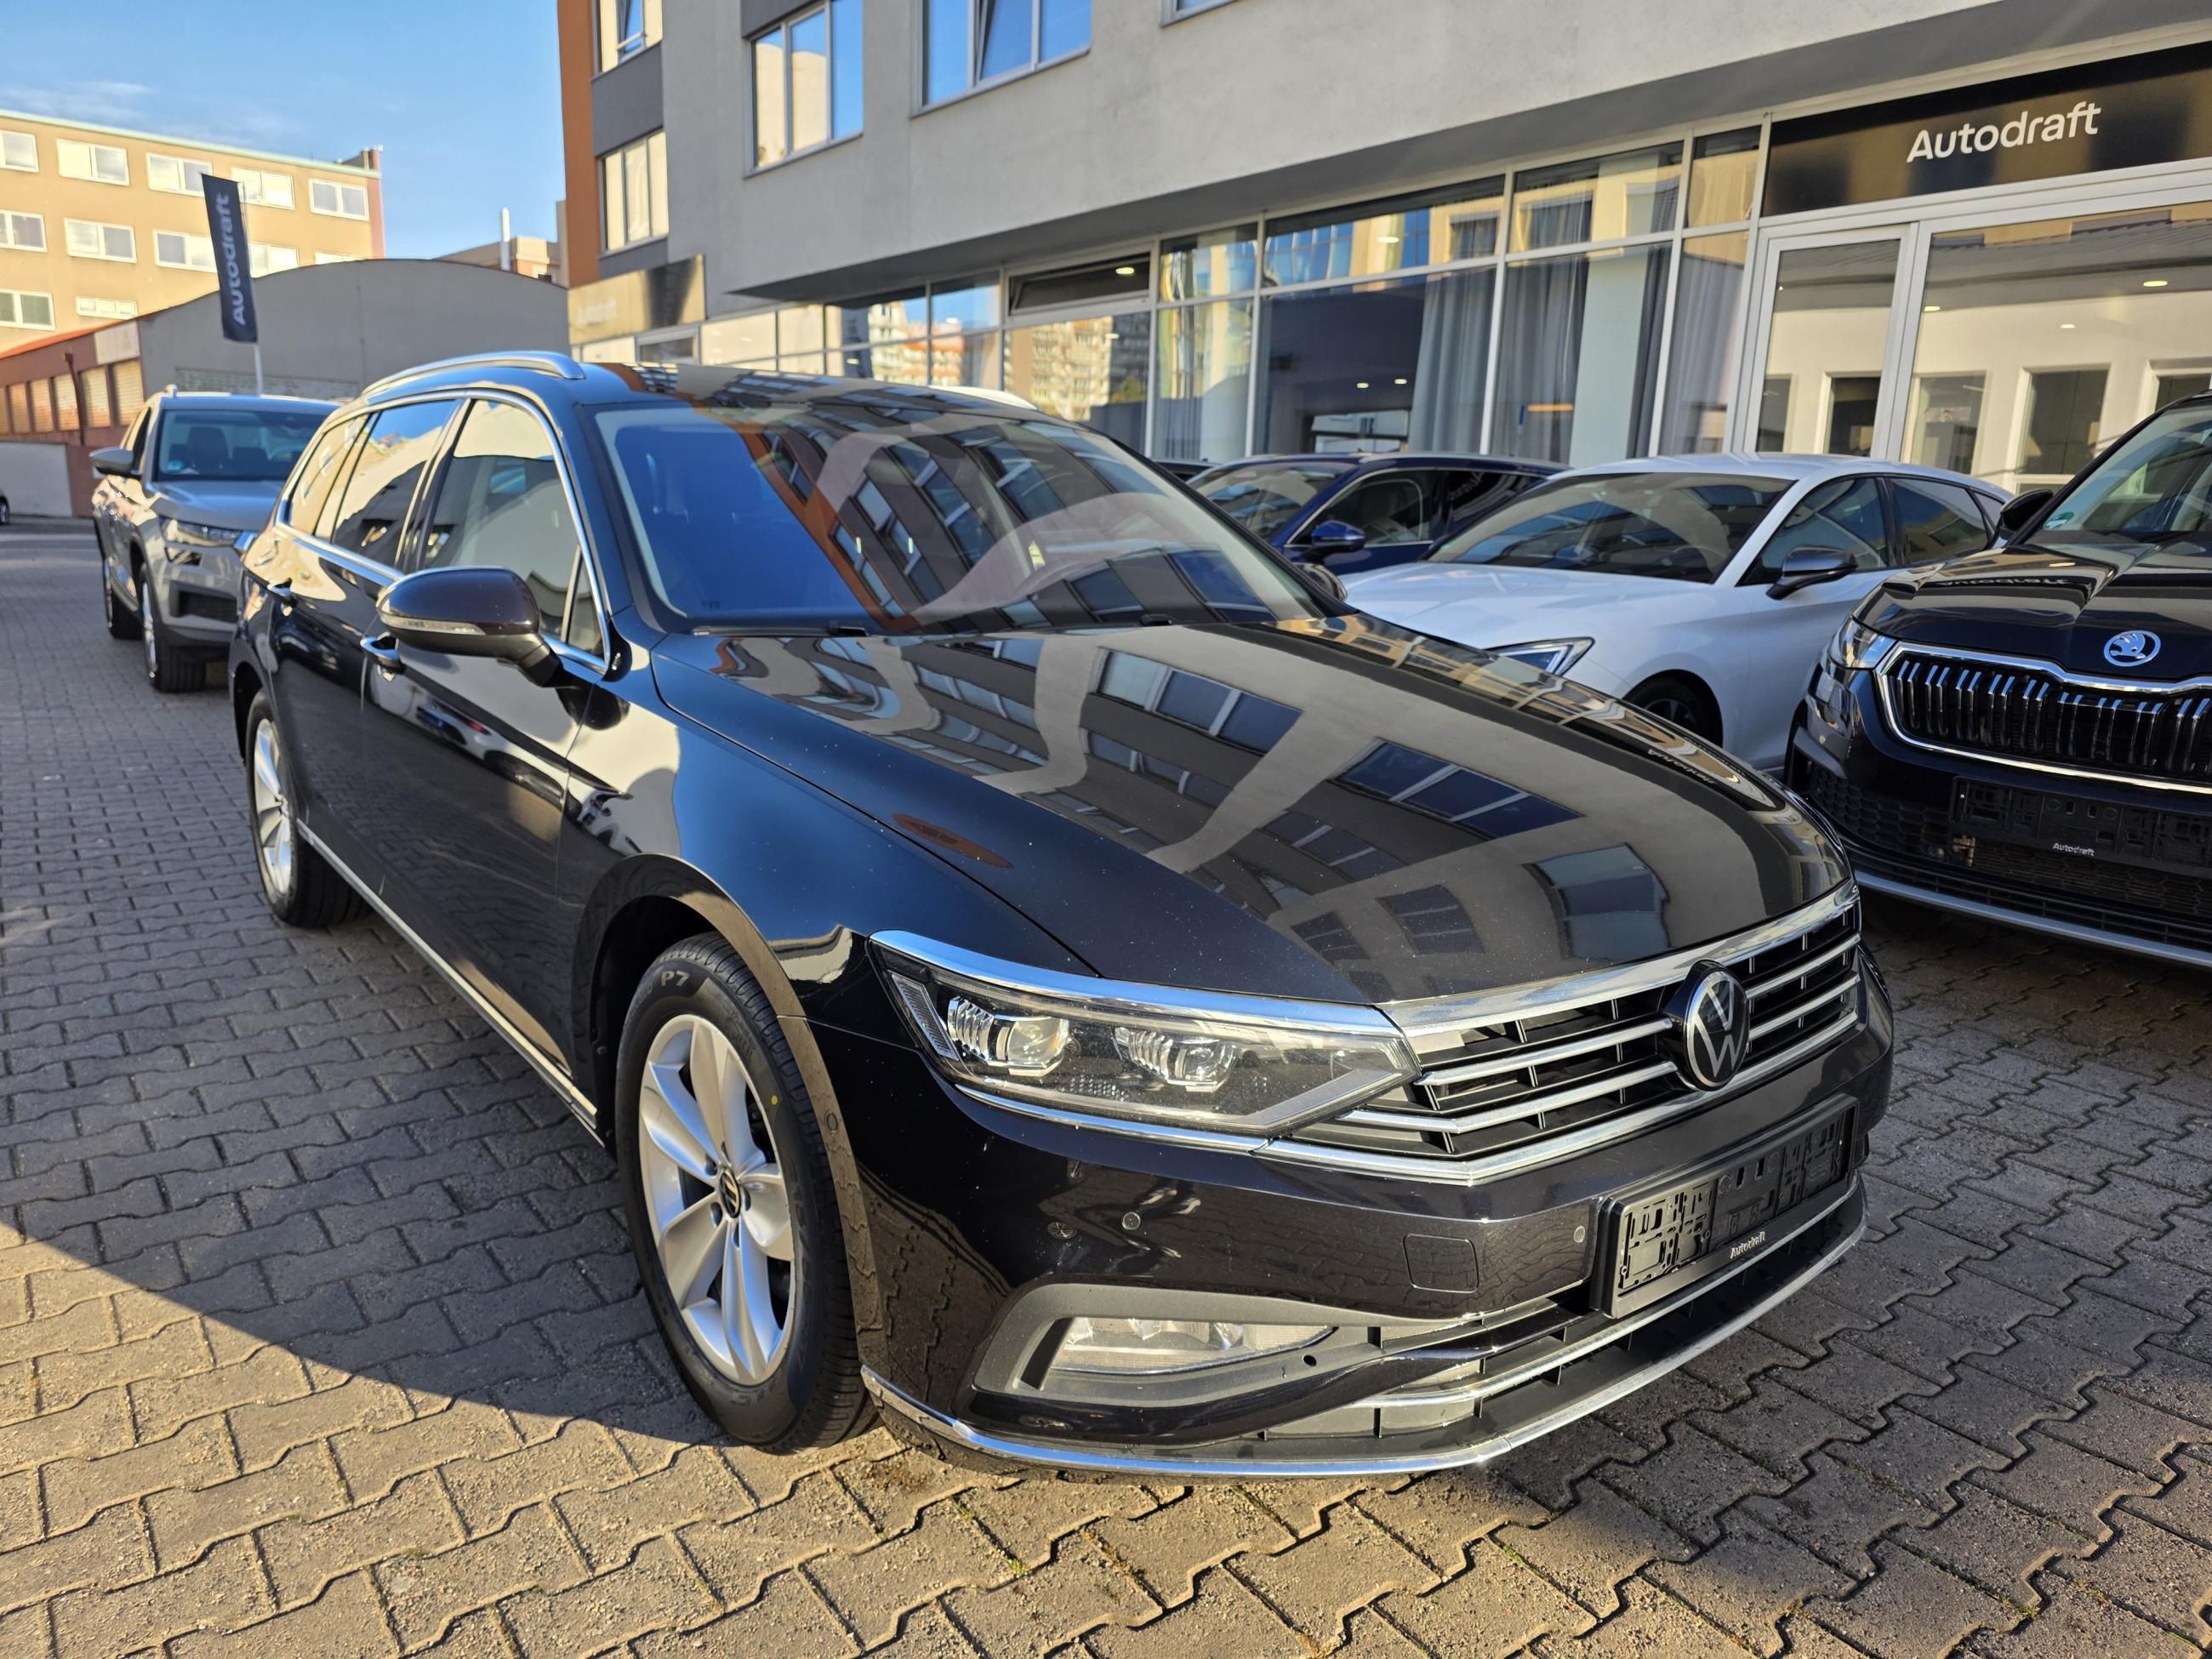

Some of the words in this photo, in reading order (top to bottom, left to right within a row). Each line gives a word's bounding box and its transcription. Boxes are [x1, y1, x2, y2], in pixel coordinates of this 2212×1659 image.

[1906, 101, 2101, 163] Autodraft
[215, 191, 246, 327] Autodraft
[660, 970, 690, 987] P7
[1730, 1231, 1765, 1259] Autodraft
